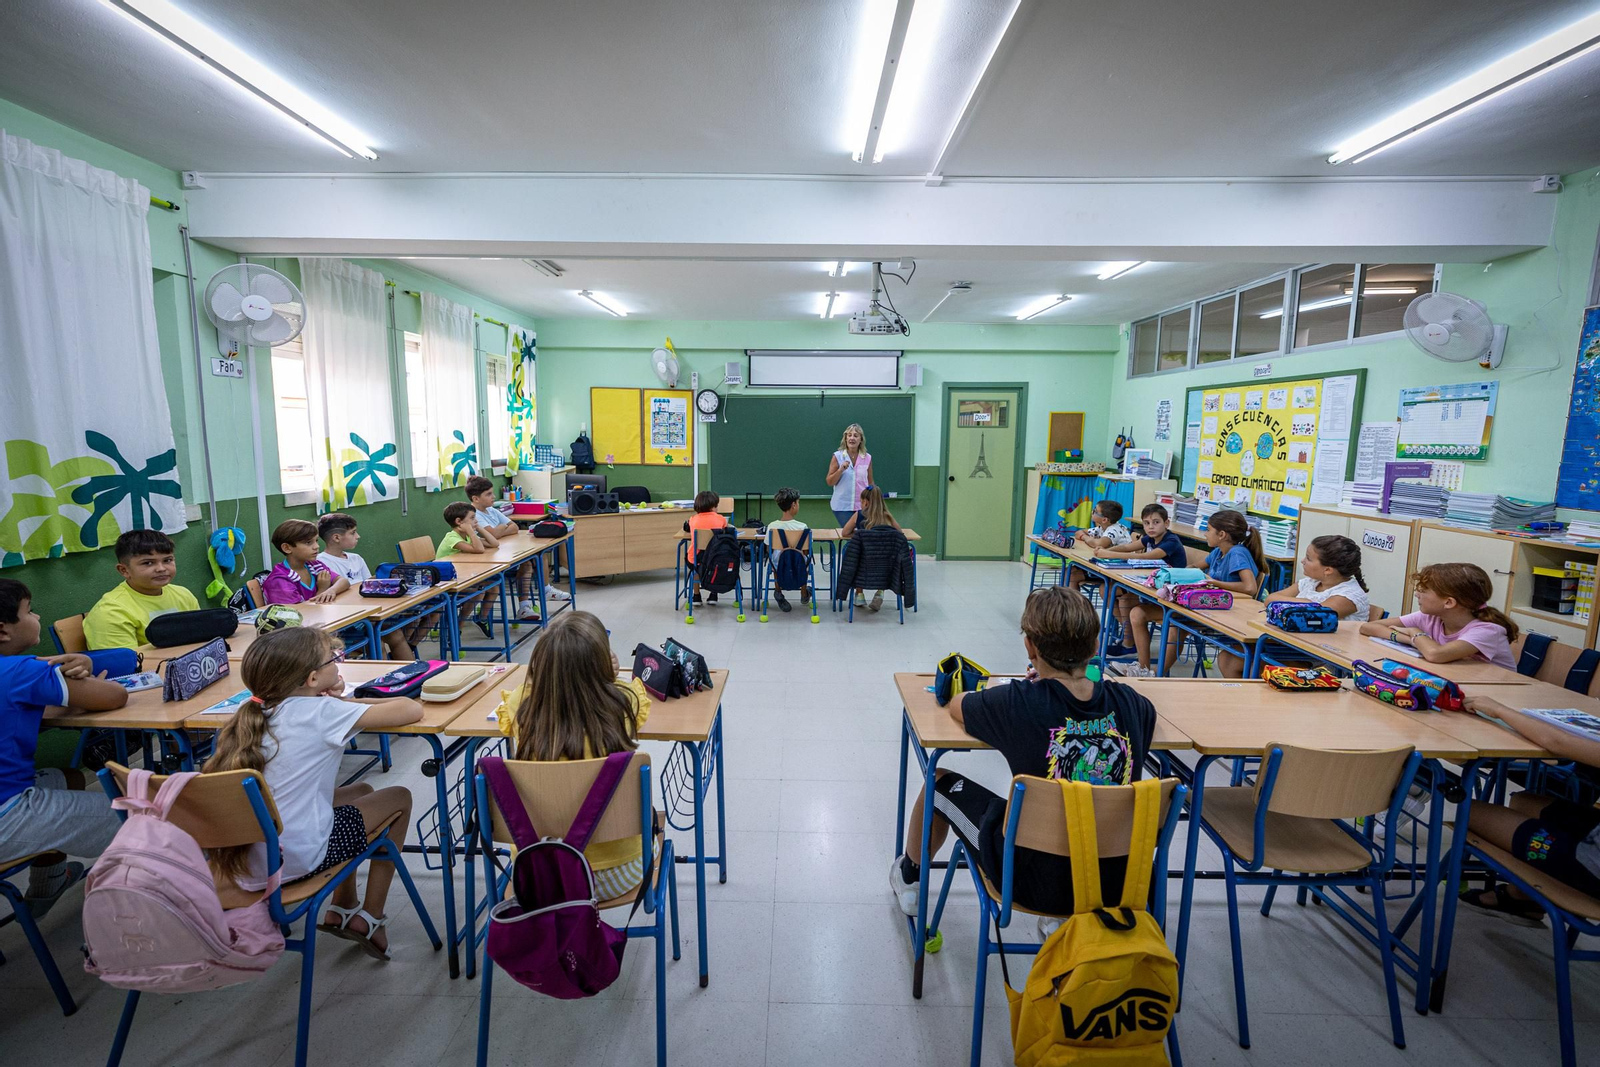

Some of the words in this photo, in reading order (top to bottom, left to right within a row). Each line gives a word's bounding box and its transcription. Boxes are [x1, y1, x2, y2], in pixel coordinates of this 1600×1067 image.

[219, 360, 235, 373] Fan
[1215, 410, 1287, 461] CONSECUENCIAS
[1212, 473, 1238, 487] CAMBIO
[1241, 476, 1285, 493] CLIMÁTICO
[1363, 532, 1394, 549] Cupboard
[1066, 711, 1117, 736] ELEMET
[1060, 988, 1171, 1041] VANS
